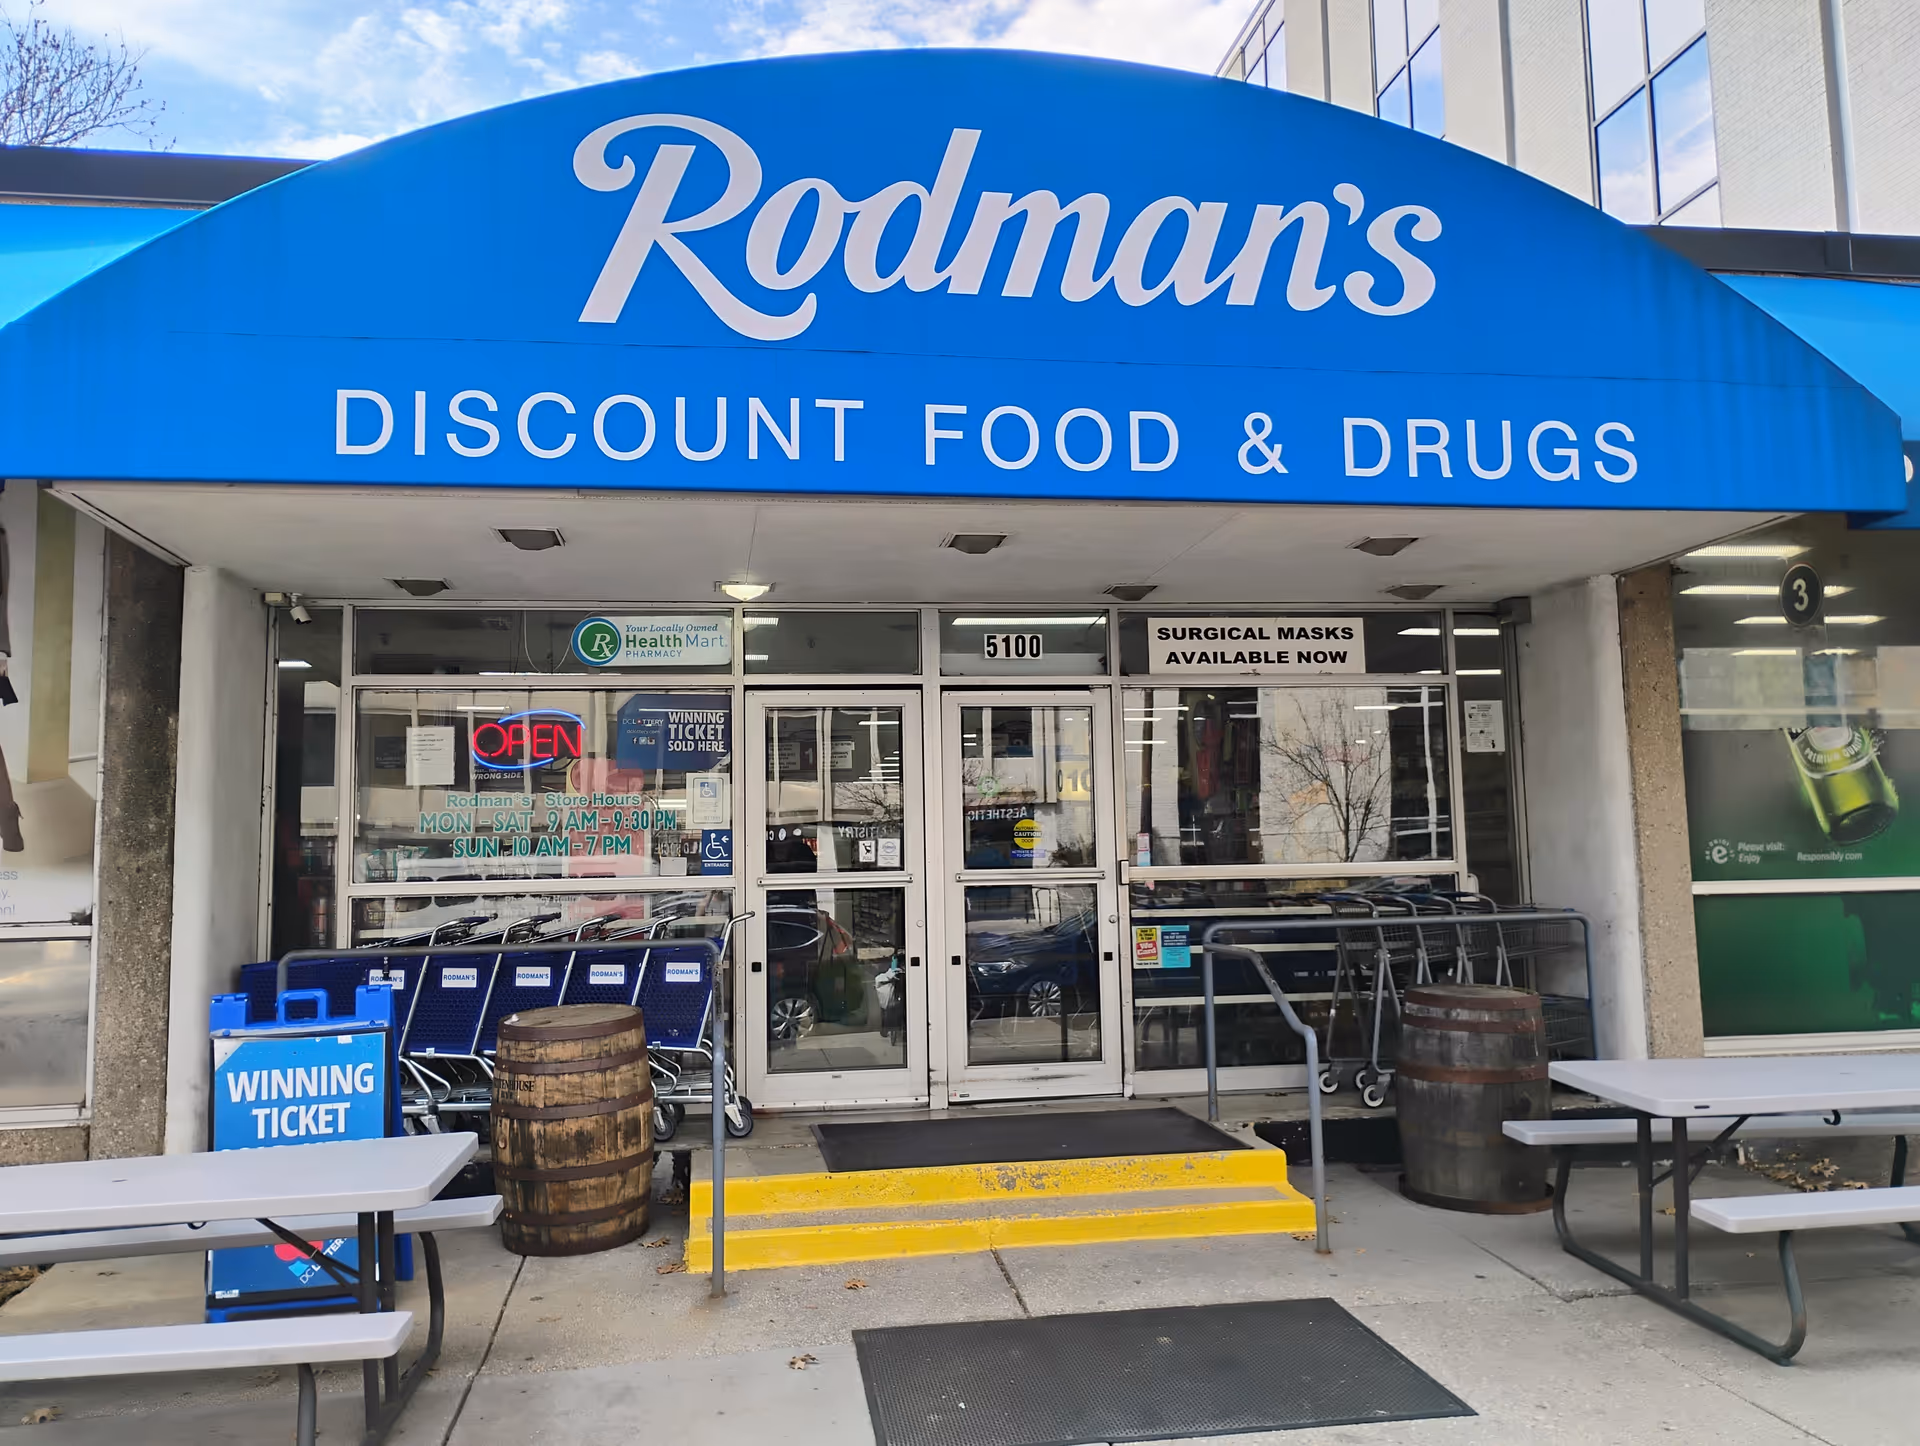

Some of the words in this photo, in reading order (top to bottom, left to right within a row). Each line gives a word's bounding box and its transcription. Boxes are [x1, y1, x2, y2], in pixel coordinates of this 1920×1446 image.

[573, 113, 1442, 340] Rodman's
[336, 389, 864, 462] DISCOUNT
[925, 404, 1180, 472] FOOD
[1238, 412, 1289, 475] &
[1343, 417, 1639, 483] DRUGS
[1792, 578, 1809, 611] 3
[626, 624, 648, 632] Your
[650, 624, 684, 634] Locally
[686, 623, 718, 632] Owned
[1157, 627, 1270, 640] SURGICAL
[1277, 627, 1354, 640] MASKS
[626, 634, 682, 648] Health
[986, 635, 1040, 658] 5100
[626, 650, 682, 658] PHARMACY
[1165, 651, 1290, 665] AVAILABLE
[1297, 651, 1347, 664] NOW
[668, 712, 724, 724] WINNING
[668, 724, 724, 740] TICKET
[473, 723, 582, 757] OPEN
[668, 740, 694, 751] SOLD
[698, 740, 724, 751] HERE
[471, 772, 501, 780] WRONG
[545, 792, 587, 806] Store
[592, 793, 641, 806] Hours
[420, 811, 473, 833] MON
[494, 810, 534, 833] SAT
[547, 810, 560, 832] 9
[654, 809, 677, 831] PM
[453, 836, 500, 858] SUN
[512, 836, 530, 857] 10
[602, 835, 632, 856] PM
[1738, 854, 1761, 864] Enjoy
[227, 1062, 375, 1103] WINNING
[252, 1101, 351, 1140] TICKET
